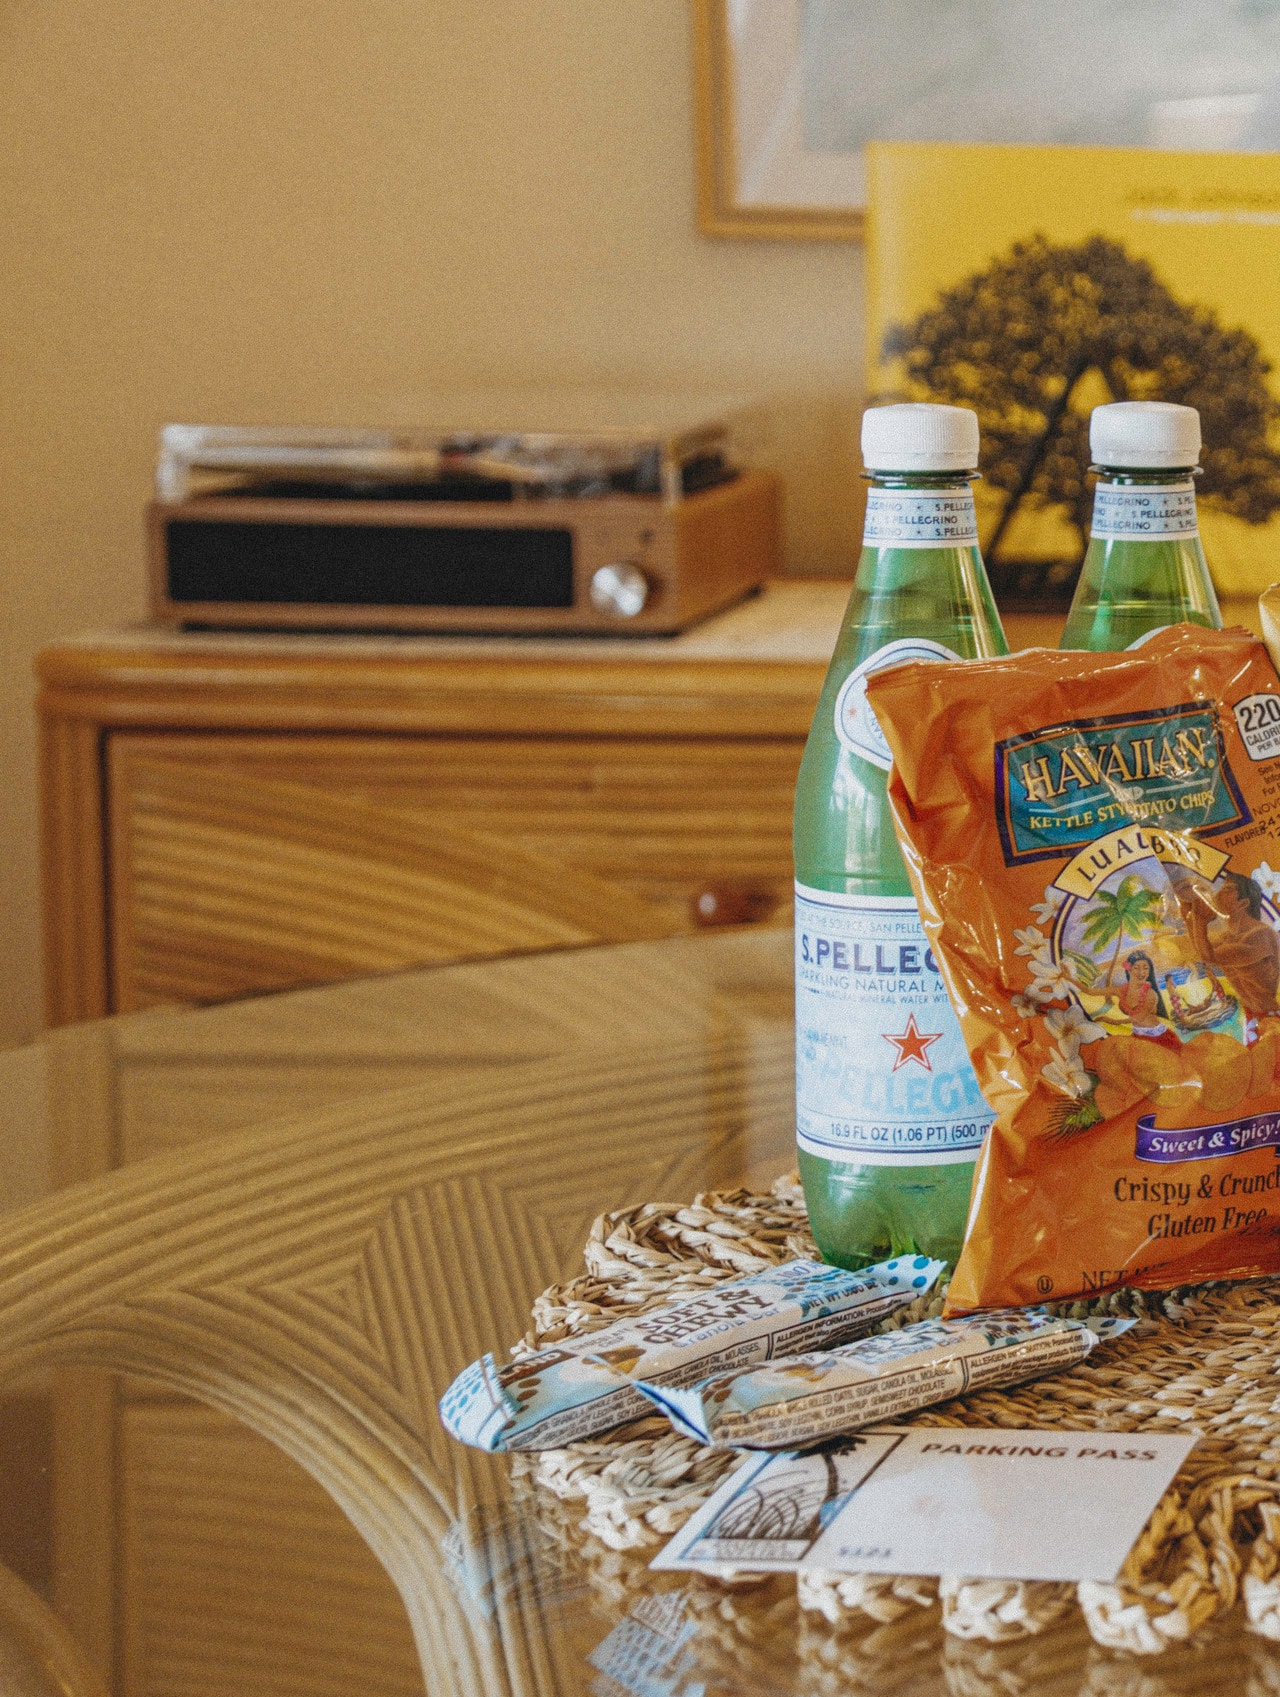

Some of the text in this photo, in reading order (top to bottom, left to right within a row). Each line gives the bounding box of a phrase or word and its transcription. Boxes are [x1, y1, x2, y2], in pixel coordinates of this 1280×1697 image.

[1029, 811, 1093, 830] KETTLE
[1180, 790, 1216, 811] CHIPS
[855, 979, 927, 994] NATURAL
[830, 1123, 850, 1137] 16.9
[853, 1124, 867, 1140] FL
[871, 1127, 889, 1141] OZ
[892, 1128, 923, 1144] (1.06
[926, 1126, 948, 1143] PT)
[951, 1124, 978, 1142] (500
[1149, 1136, 1204, 1154] Sweet
[1207, 1131, 1225, 1149] &
[1114, 1177, 1191, 1206] Crispy
[1197, 1174, 1213, 1199] &
[1148, 1213, 1217, 1240] Gluten
[635, 1300, 713, 1332] SOFT
[643, 1294, 773, 1345] CHEWY
[921, 1443, 1159, 1461] PARKING PASS
